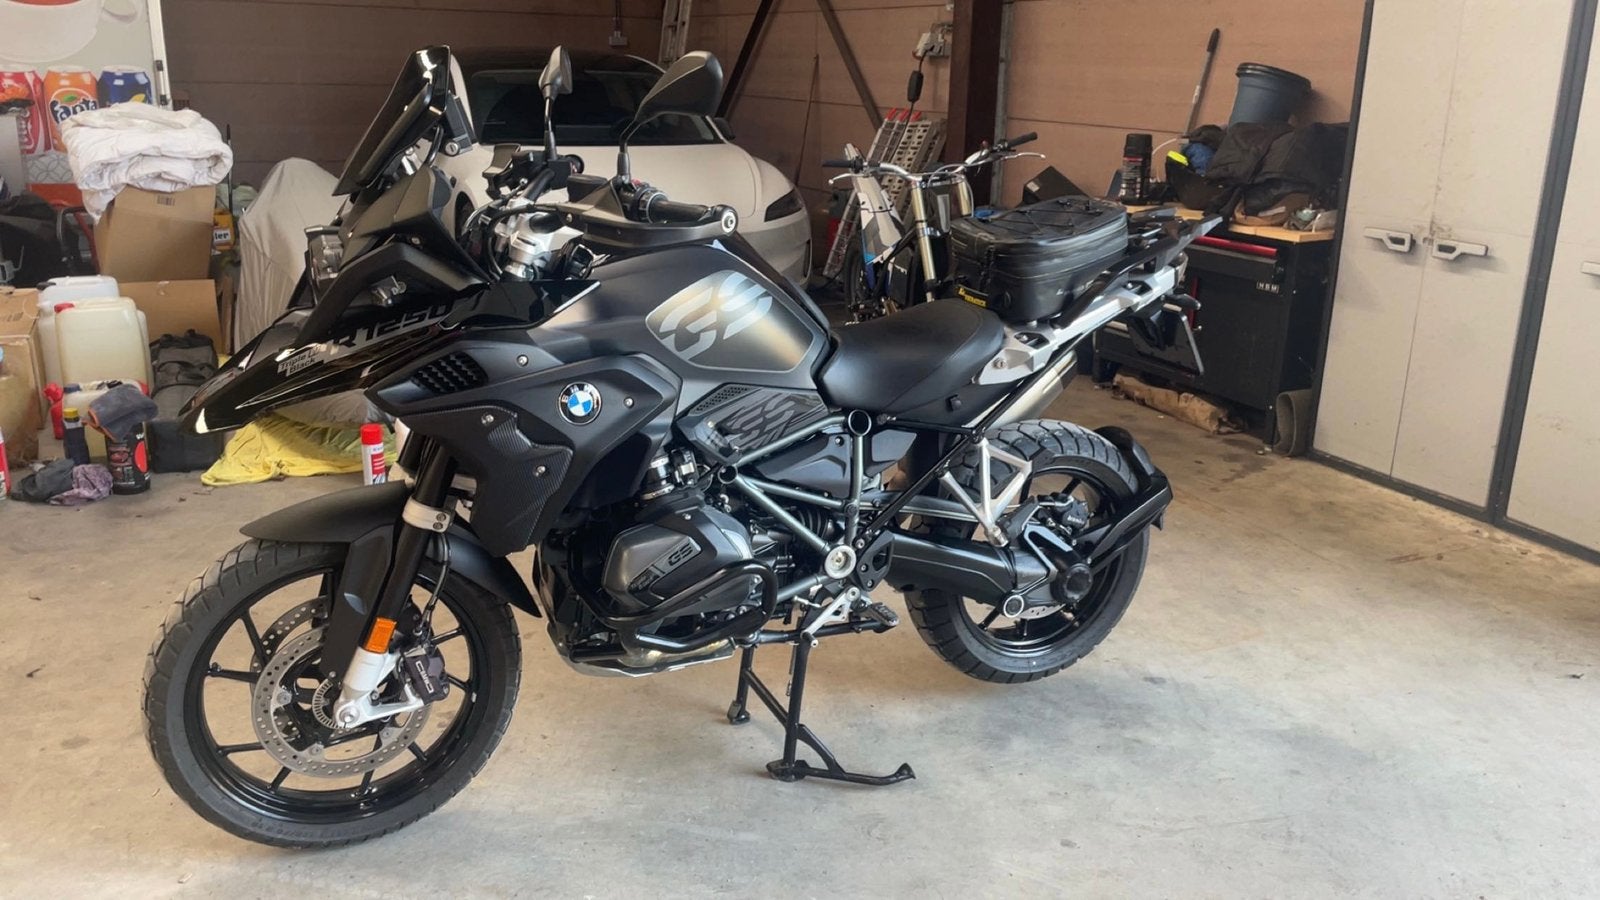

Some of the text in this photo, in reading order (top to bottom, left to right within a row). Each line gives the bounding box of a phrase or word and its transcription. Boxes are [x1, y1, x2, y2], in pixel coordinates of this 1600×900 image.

[50, 98, 97, 124] Fanta
[659, 271, 773, 361] GS
[668, 543, 693, 566] GS
